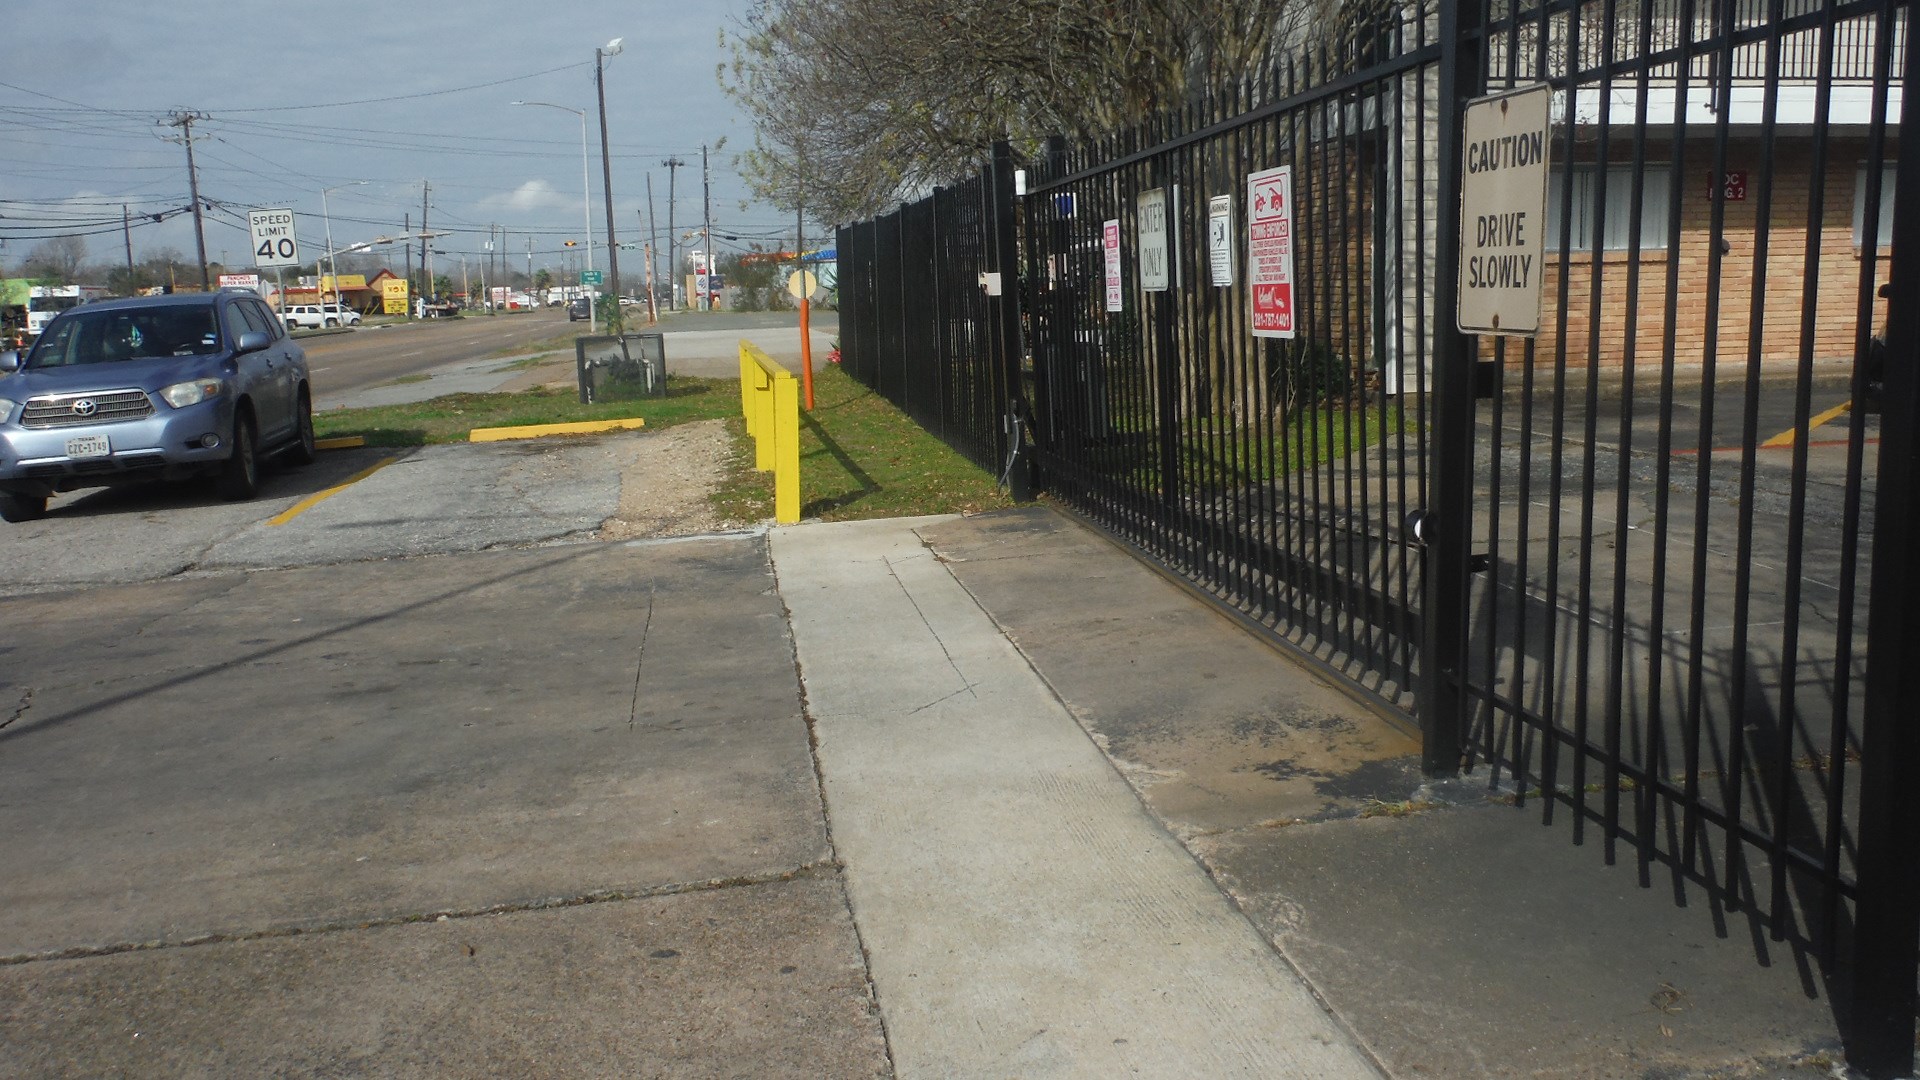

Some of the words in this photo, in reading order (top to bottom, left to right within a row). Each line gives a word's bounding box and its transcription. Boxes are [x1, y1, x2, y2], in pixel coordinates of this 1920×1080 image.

[1468, 130, 1543, 174] CAUTION
[1738, 187, 1744, 199] 2
[252, 214, 291, 225] SPEED
[1140, 202, 1164, 234] ENTER
[1266, 220, 1288, 239] ENFORCED
[1476, 211, 1526, 248] DRIVE
[258, 226, 287, 237] LIMIT
[257, 238, 295, 259] 40
[1143, 246, 1162, 277] ONLY
[1468, 254, 1532, 289] SLOWLY
